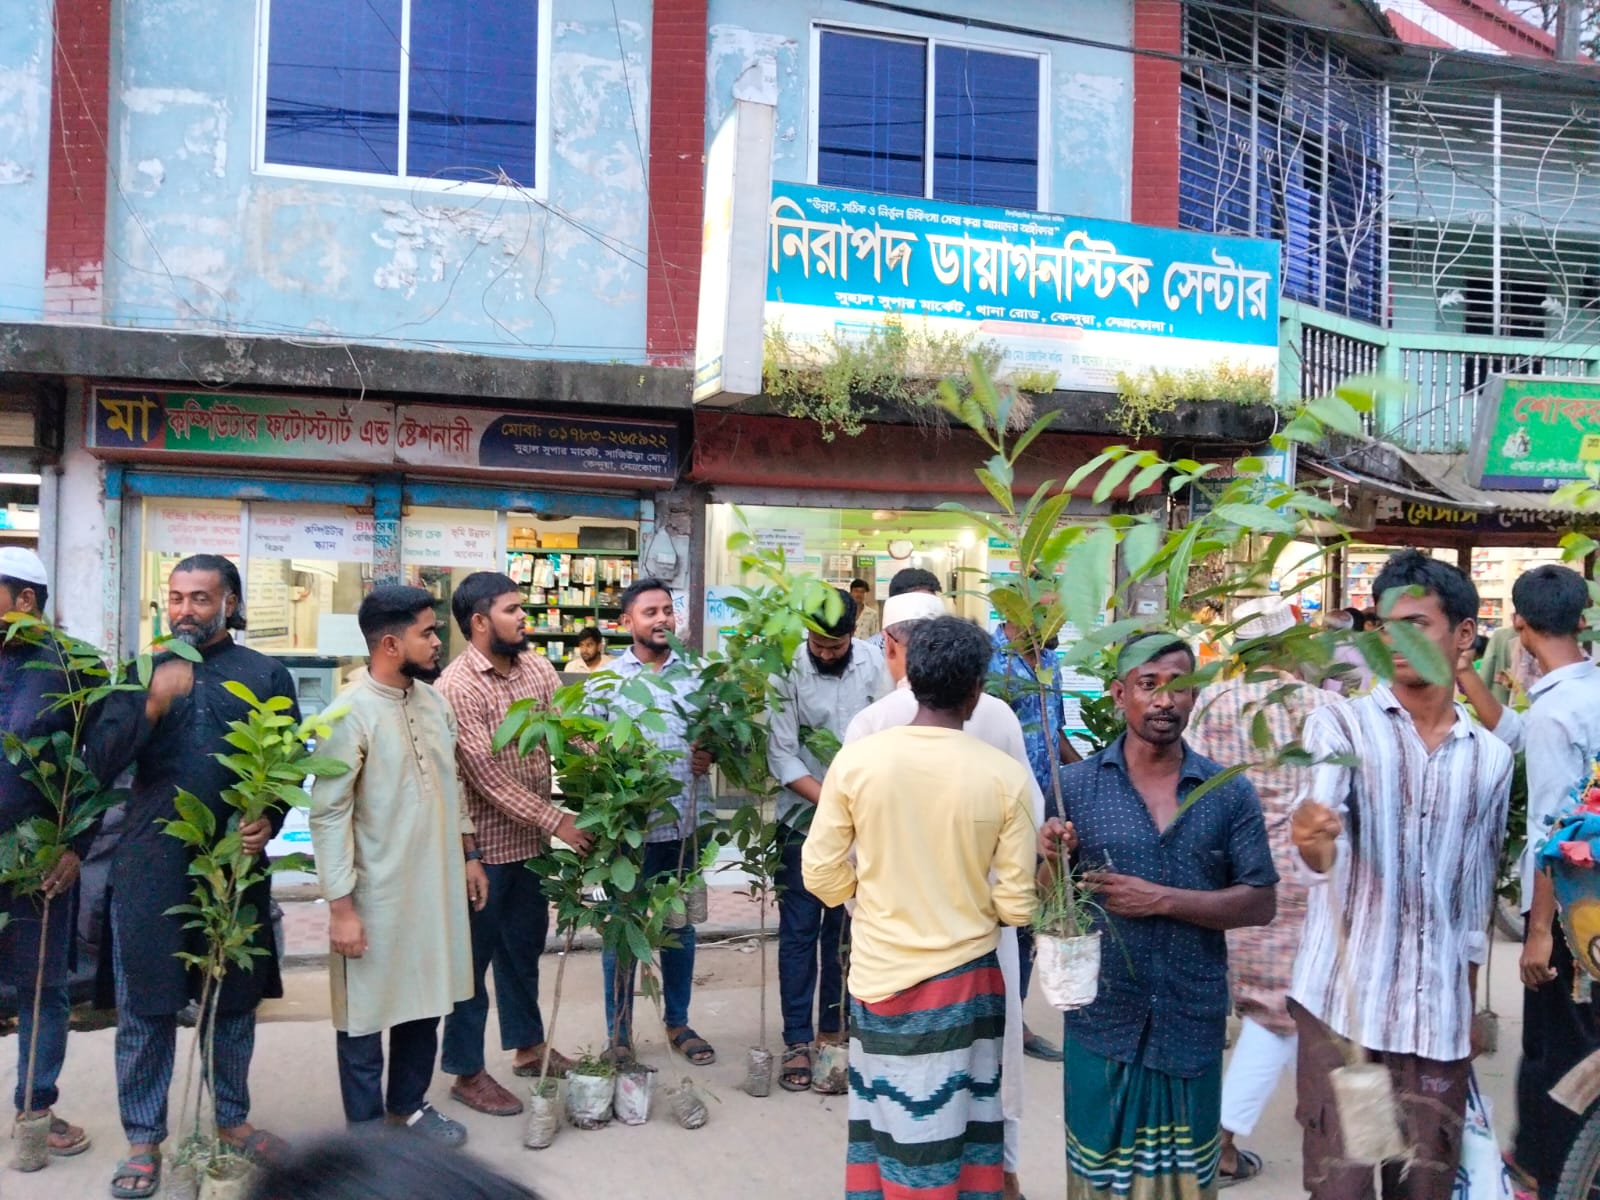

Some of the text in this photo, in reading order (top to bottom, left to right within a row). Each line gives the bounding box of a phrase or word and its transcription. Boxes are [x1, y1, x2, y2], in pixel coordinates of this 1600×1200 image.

[868, 206, 875, 216] ও
[941, 214, 961, 227] সেবা
[963, 217, 980, 229] করা
[983, 219, 1018, 233] আমাদের
[770, 196, 1272, 321] নিরাপদ ডায়াগনস্টিক সেন্টার
[876, 295, 917, 310] সুপার
[975, 304, 1005, 317] থানা
[98, 395, 158, 442] মা
[164, 398, 260, 441] কম্পিউটার
[360, 419, 391, 447] এন্ড
[397, 416, 473, 453] ষ্টেশনারী
[549, 427, 668, 448] ০১৭৮৩-২৬৫৯২২
[542, 446, 567, 457] সুপার
[304, 523, 344, 537] কম্পিউটার
